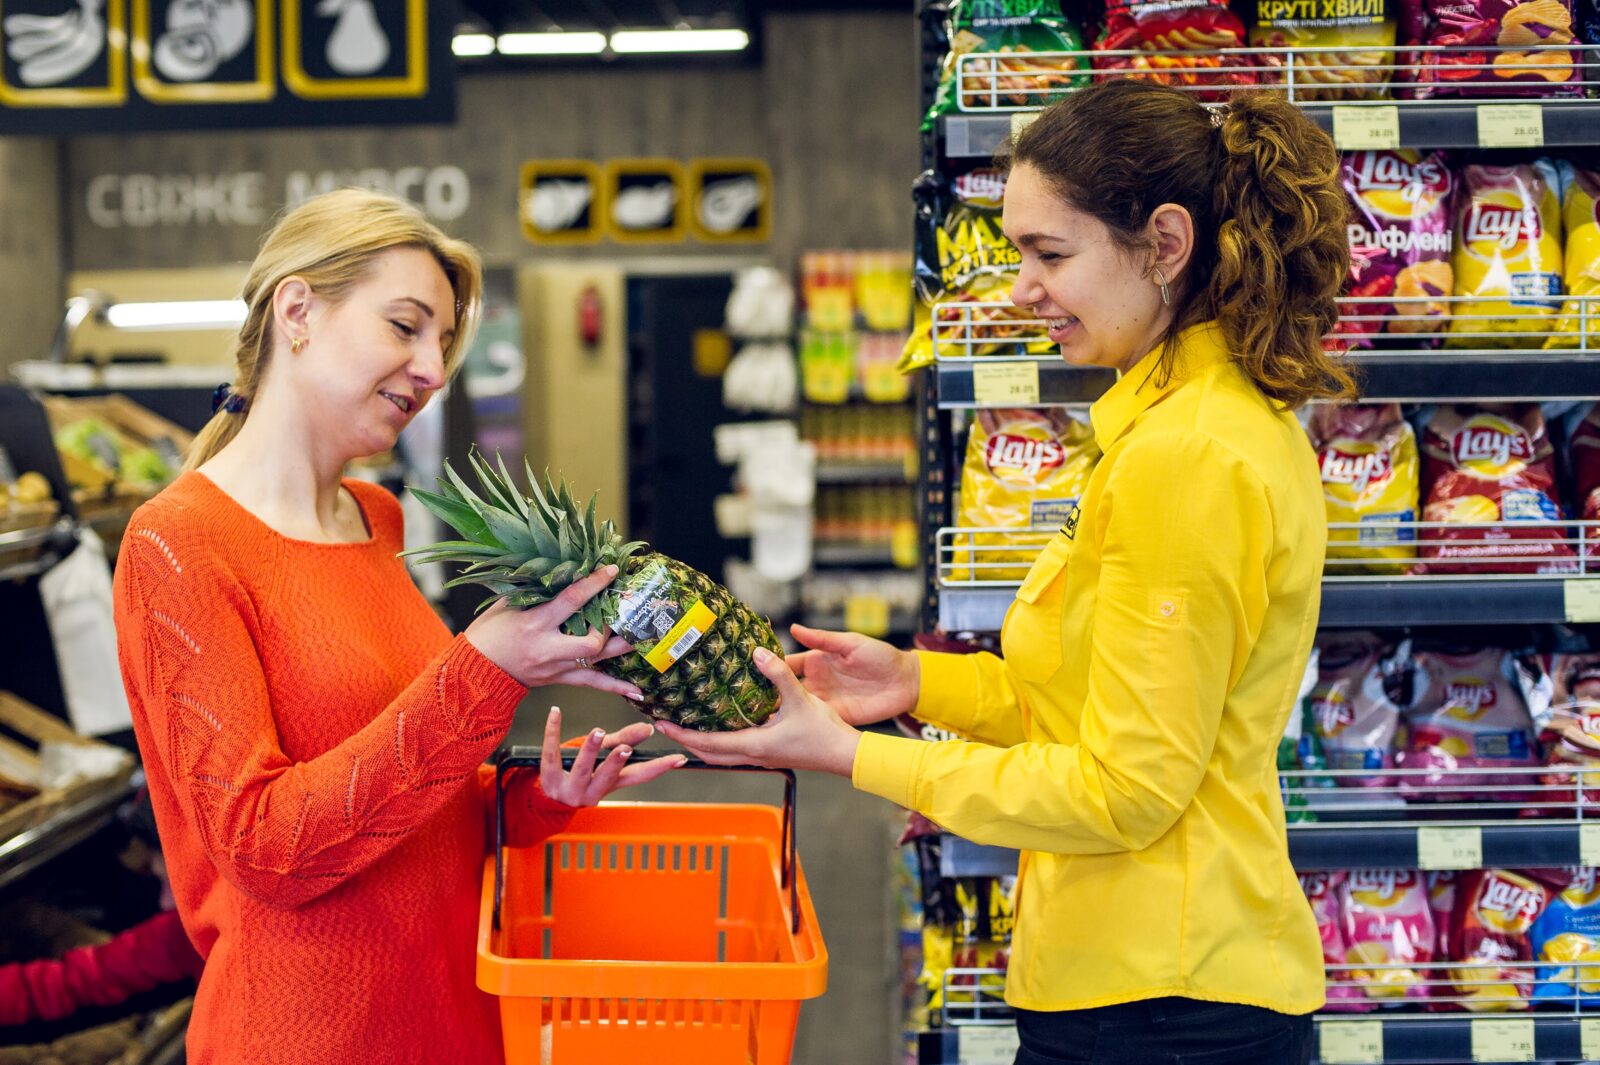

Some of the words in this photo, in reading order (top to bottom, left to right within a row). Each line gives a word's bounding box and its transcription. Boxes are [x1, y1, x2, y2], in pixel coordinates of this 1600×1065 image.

[1258, 0, 1316, 19] КРУТІ
[1322, 0, 1384, 18] ХВИЛІ
[1347, 223, 1453, 258] Рифлені
[623, 597, 657, 632] pineapple
[653, 580, 673, 599] farm
